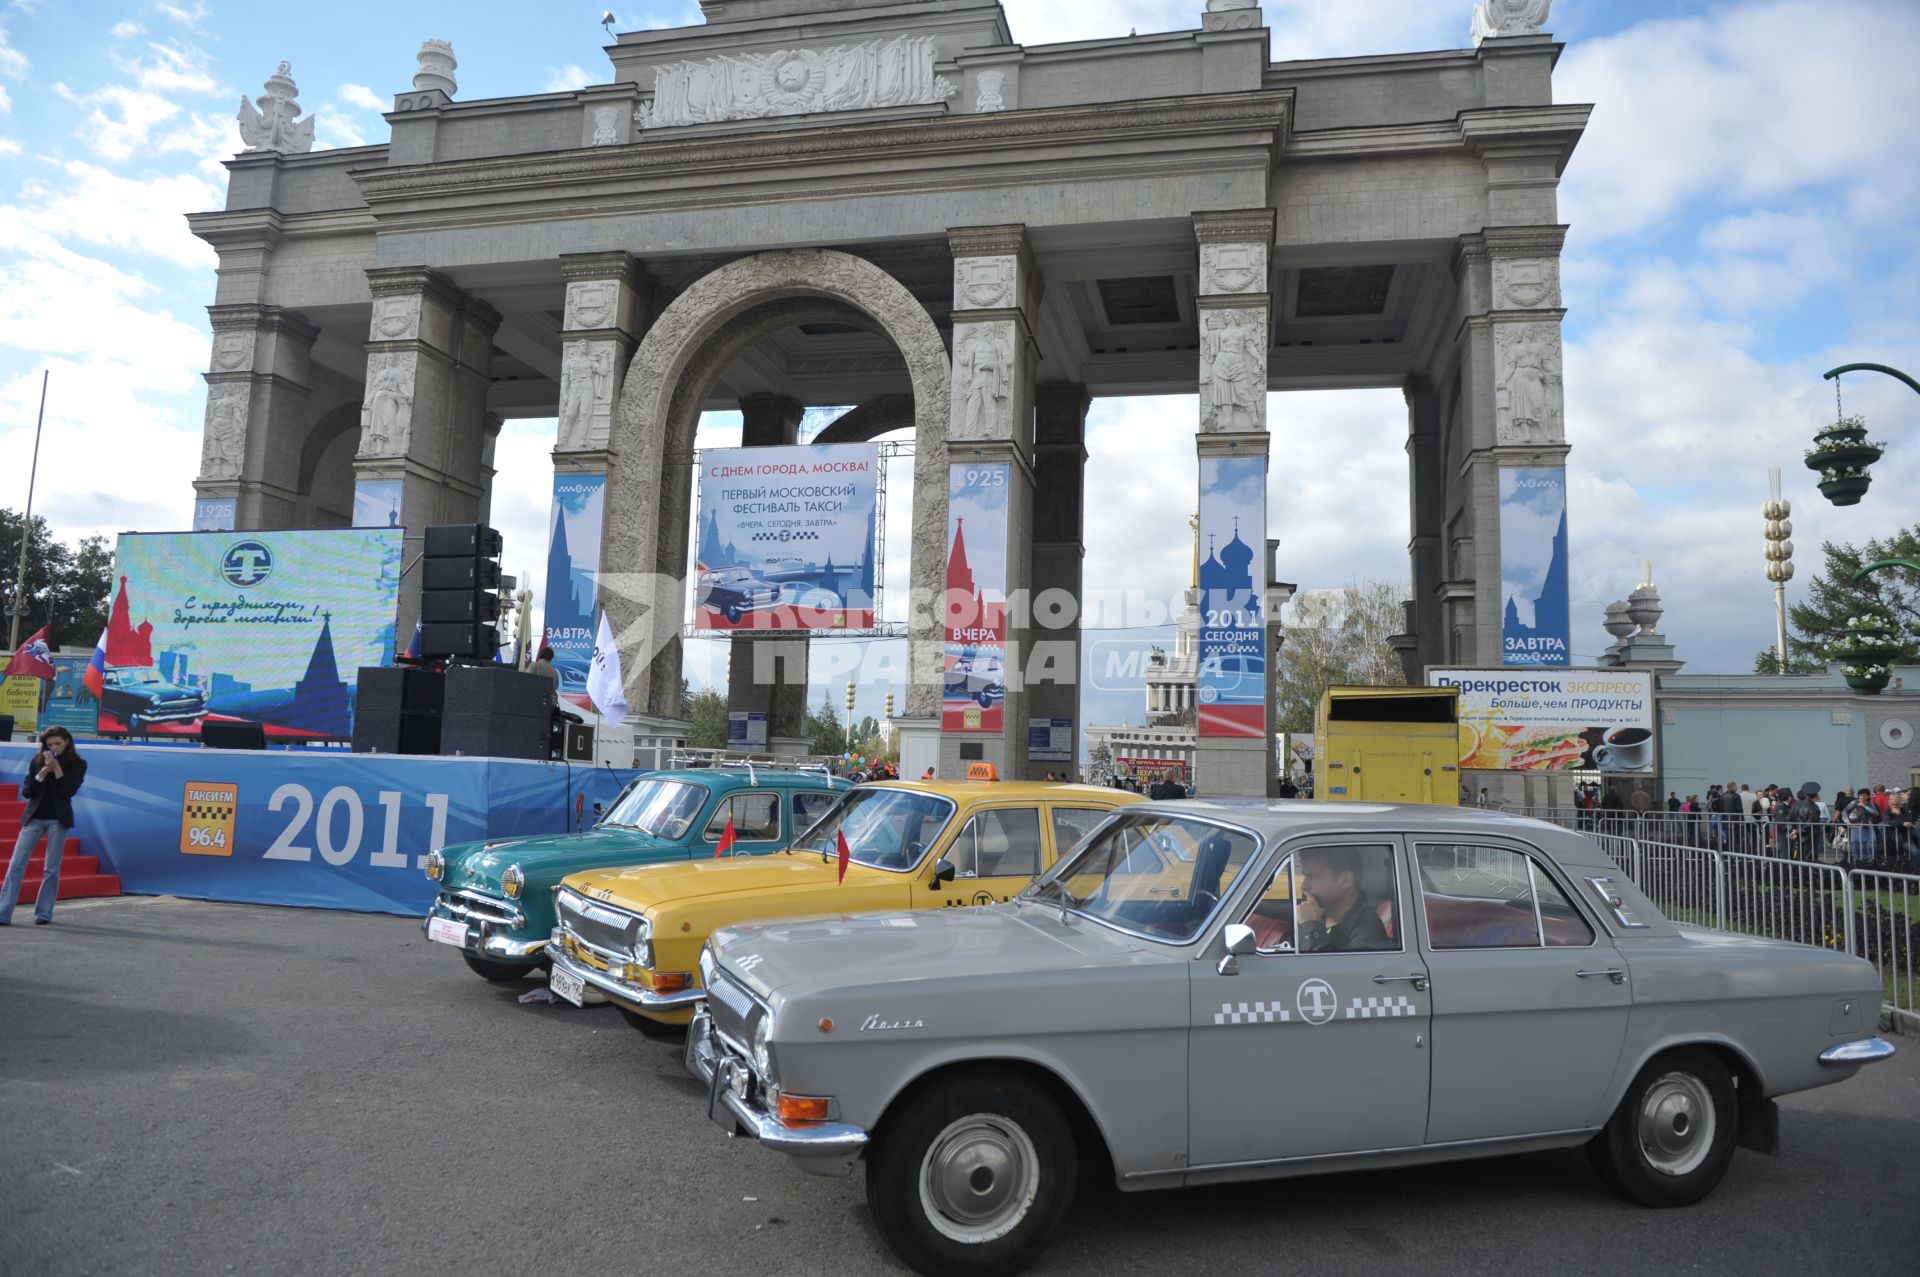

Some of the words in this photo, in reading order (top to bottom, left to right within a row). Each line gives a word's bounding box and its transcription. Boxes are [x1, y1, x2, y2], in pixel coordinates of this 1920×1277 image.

[711, 467, 718, 477] С
[720, 465, 753, 478] ДНЕМ
[757, 463, 809, 476] ГОРОДА,
[812, 461, 869, 473] МОСКВА!
[722, 486, 766, 500] ПЕРВЫЙ
[769, 483, 856, 499] МОСКОВСКИЙ
[196, 504, 233, 518] 1925
[733, 501, 801, 514] ФЕСТИВАЛЬ
[804, 500, 842, 513] ТАКСИ
[805, 518, 838, 528] ЗАВТРА»
[184, 596, 197, 609] С
[1205, 609, 1259, 628] 2011
[546, 626, 593, 640] ЗАВТРА
[952, 627, 997, 641] ВЧЕРА
[1205, 631, 1259, 642] СЕГОДНЯ
[1505, 637, 1566, 650] ЗАВТРА
[1438, 677, 1562, 695] Перекресток
[1567, 681, 1642, 694] ЭКСПРЕСС
[1571, 699, 1643, 711] ПРОДУКТЫ
[189, 790, 218, 802] ТАКСИ
[219, 792, 233, 803] FM
[262, 783, 449, 870] 2011
[189, 827, 226, 848] 96.4
